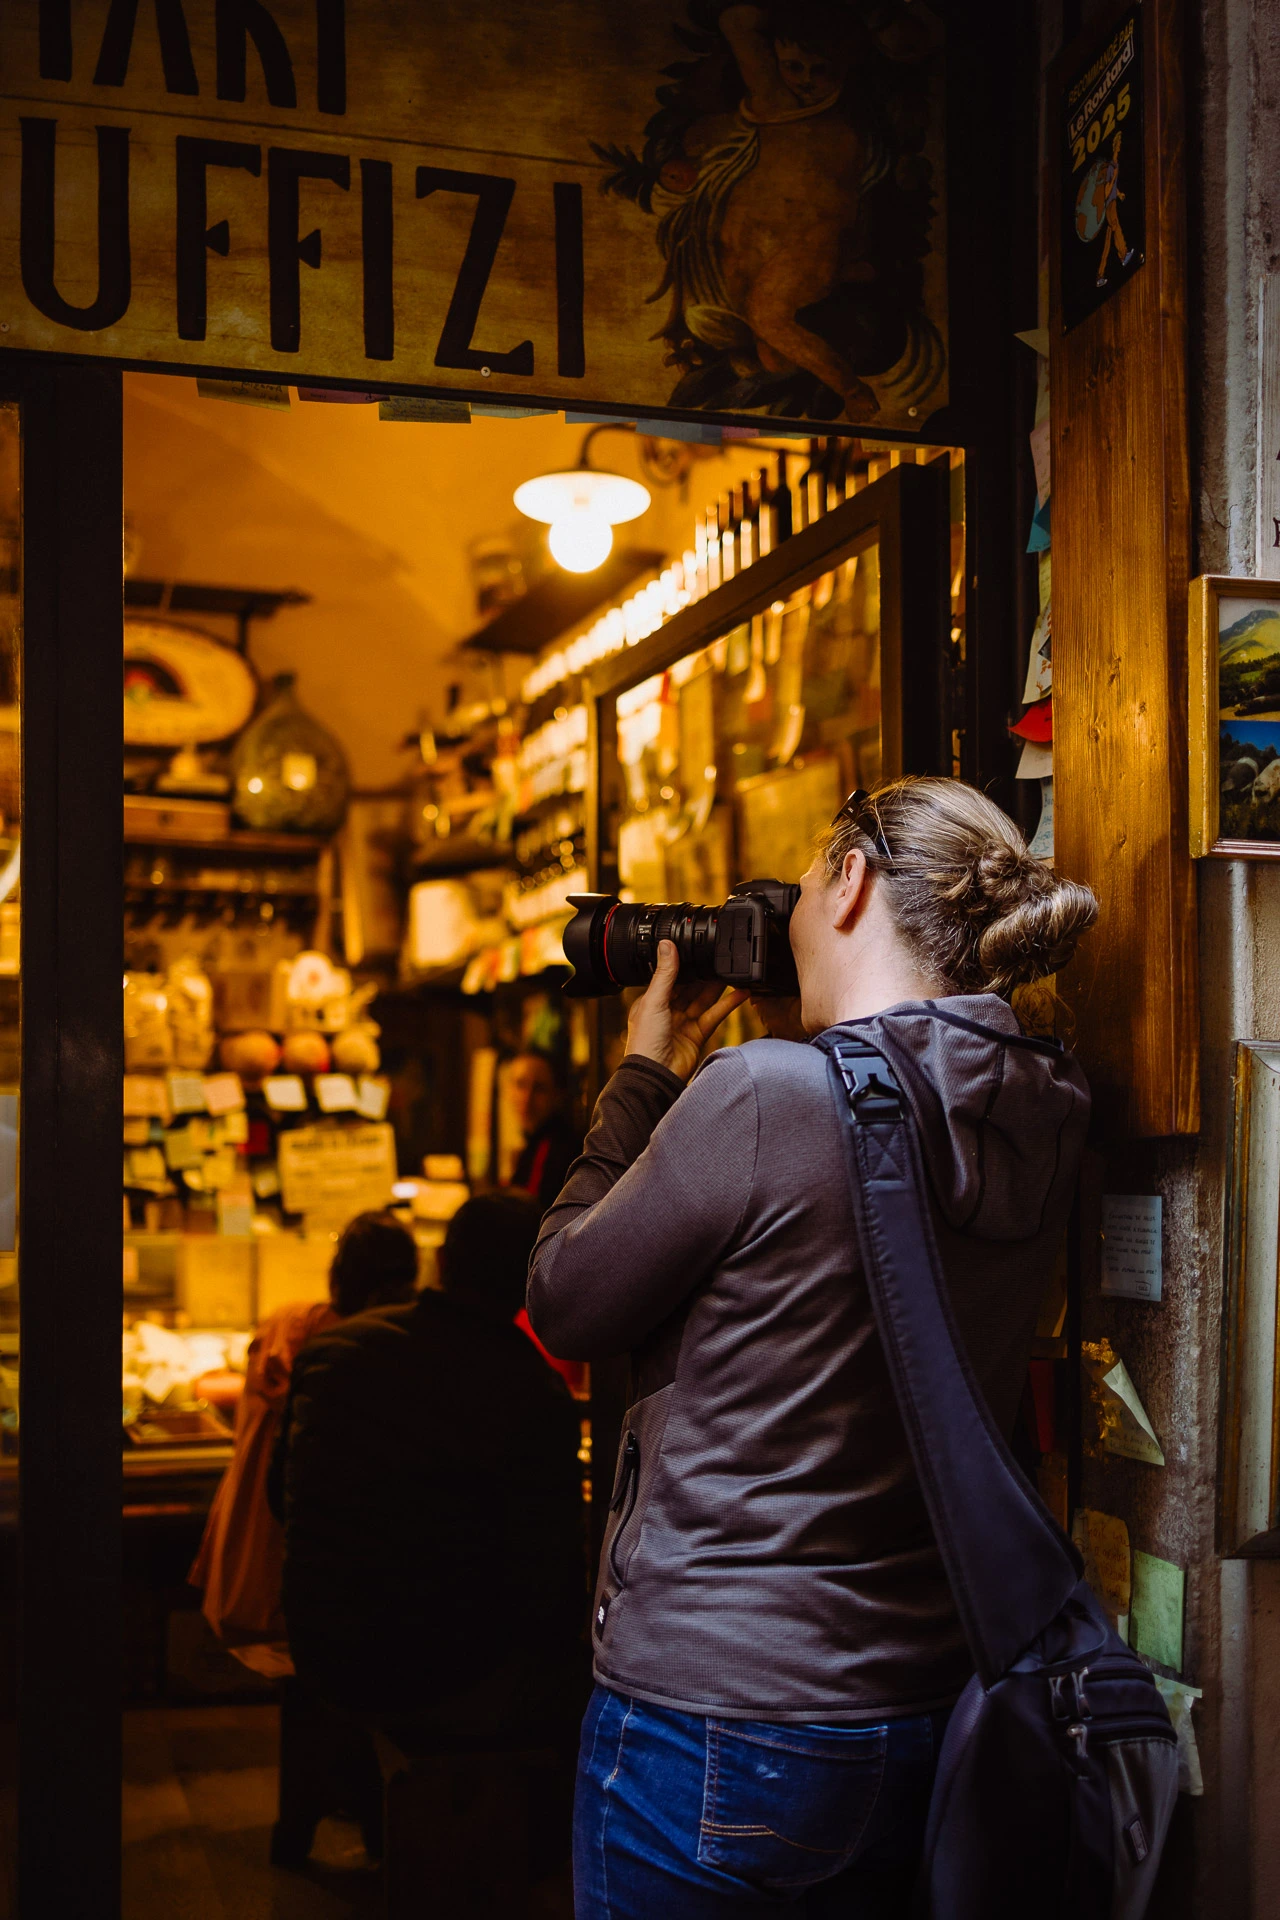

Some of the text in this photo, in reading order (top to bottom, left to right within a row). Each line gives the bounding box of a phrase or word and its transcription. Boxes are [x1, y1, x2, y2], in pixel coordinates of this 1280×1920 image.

[1070, 38, 1131, 140] Le Routard
[1072, 82, 1131, 174] 2025
[19, 117, 585, 378] UFFIZI
